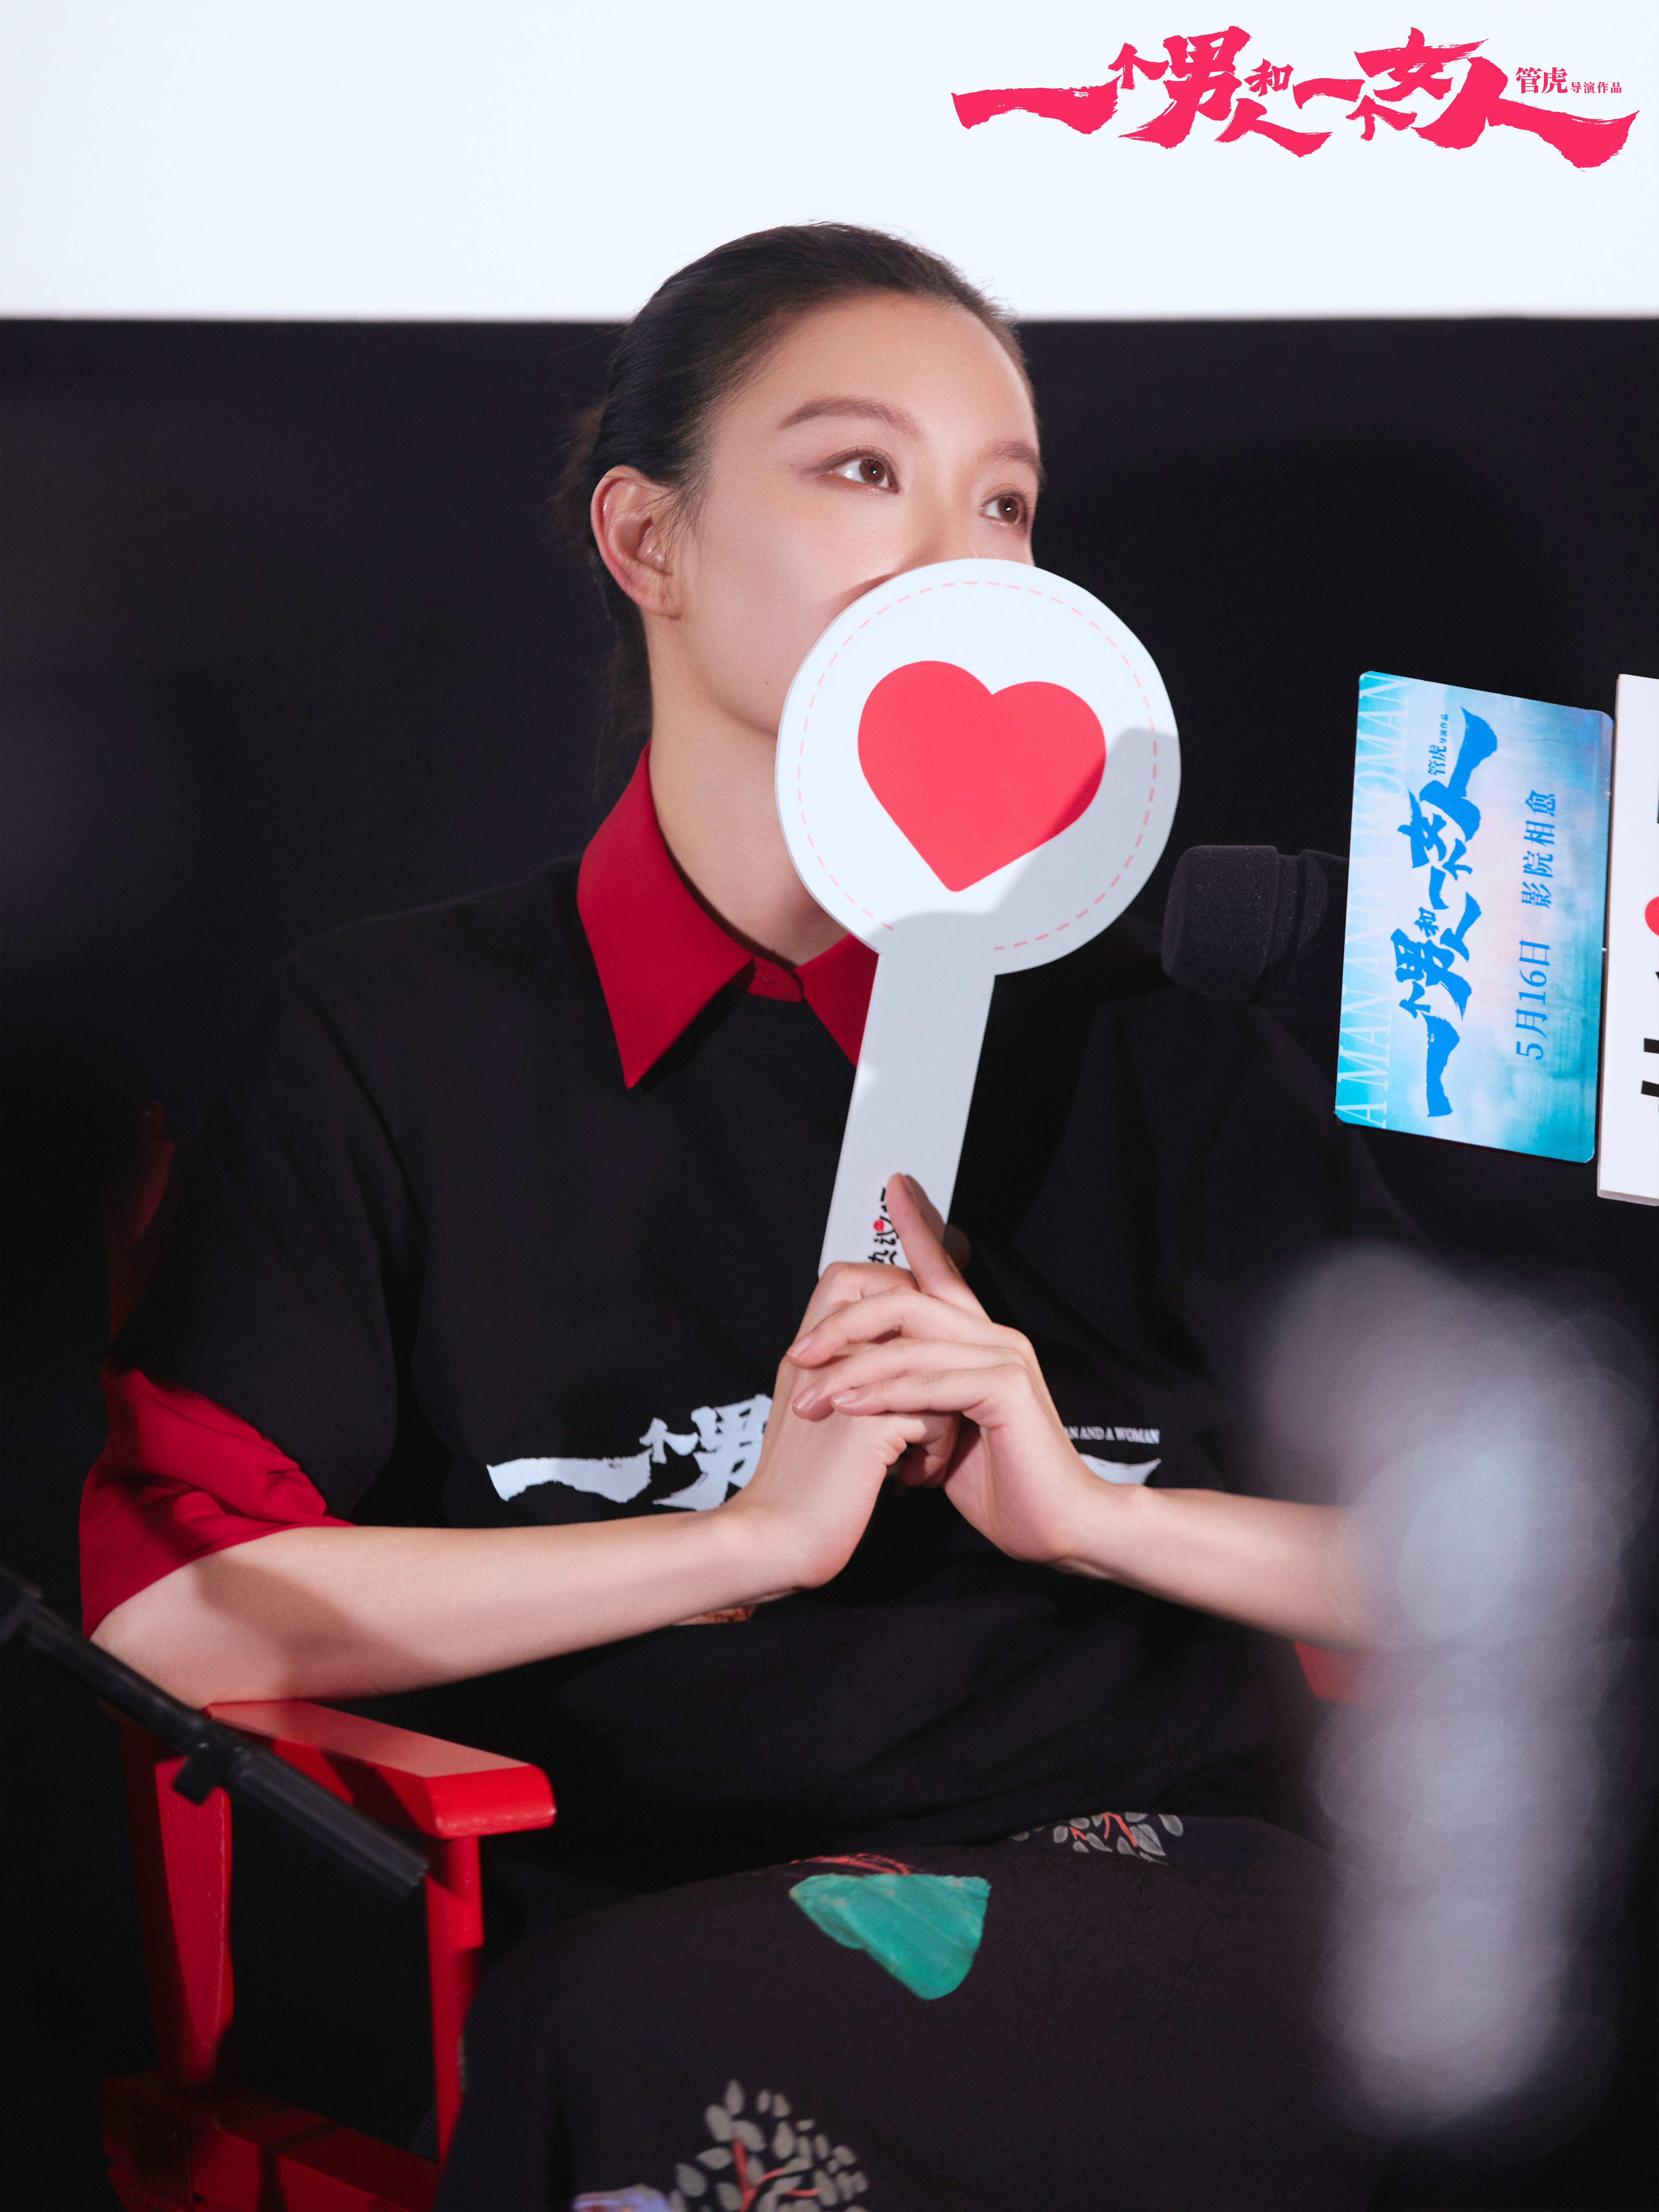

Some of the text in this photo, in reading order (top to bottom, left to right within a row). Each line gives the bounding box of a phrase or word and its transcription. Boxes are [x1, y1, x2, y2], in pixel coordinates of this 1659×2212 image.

[1335, 673, 1410, 1129] A MAN AND A WOMAN
[1515, 790, 1556, 1060] 5月16日 影院相愈
[1079, 1426, 1105, 1440] AND
[1105, 1426, 1115, 1441] A
[1114, 1426, 1160, 1444] WOMAN
